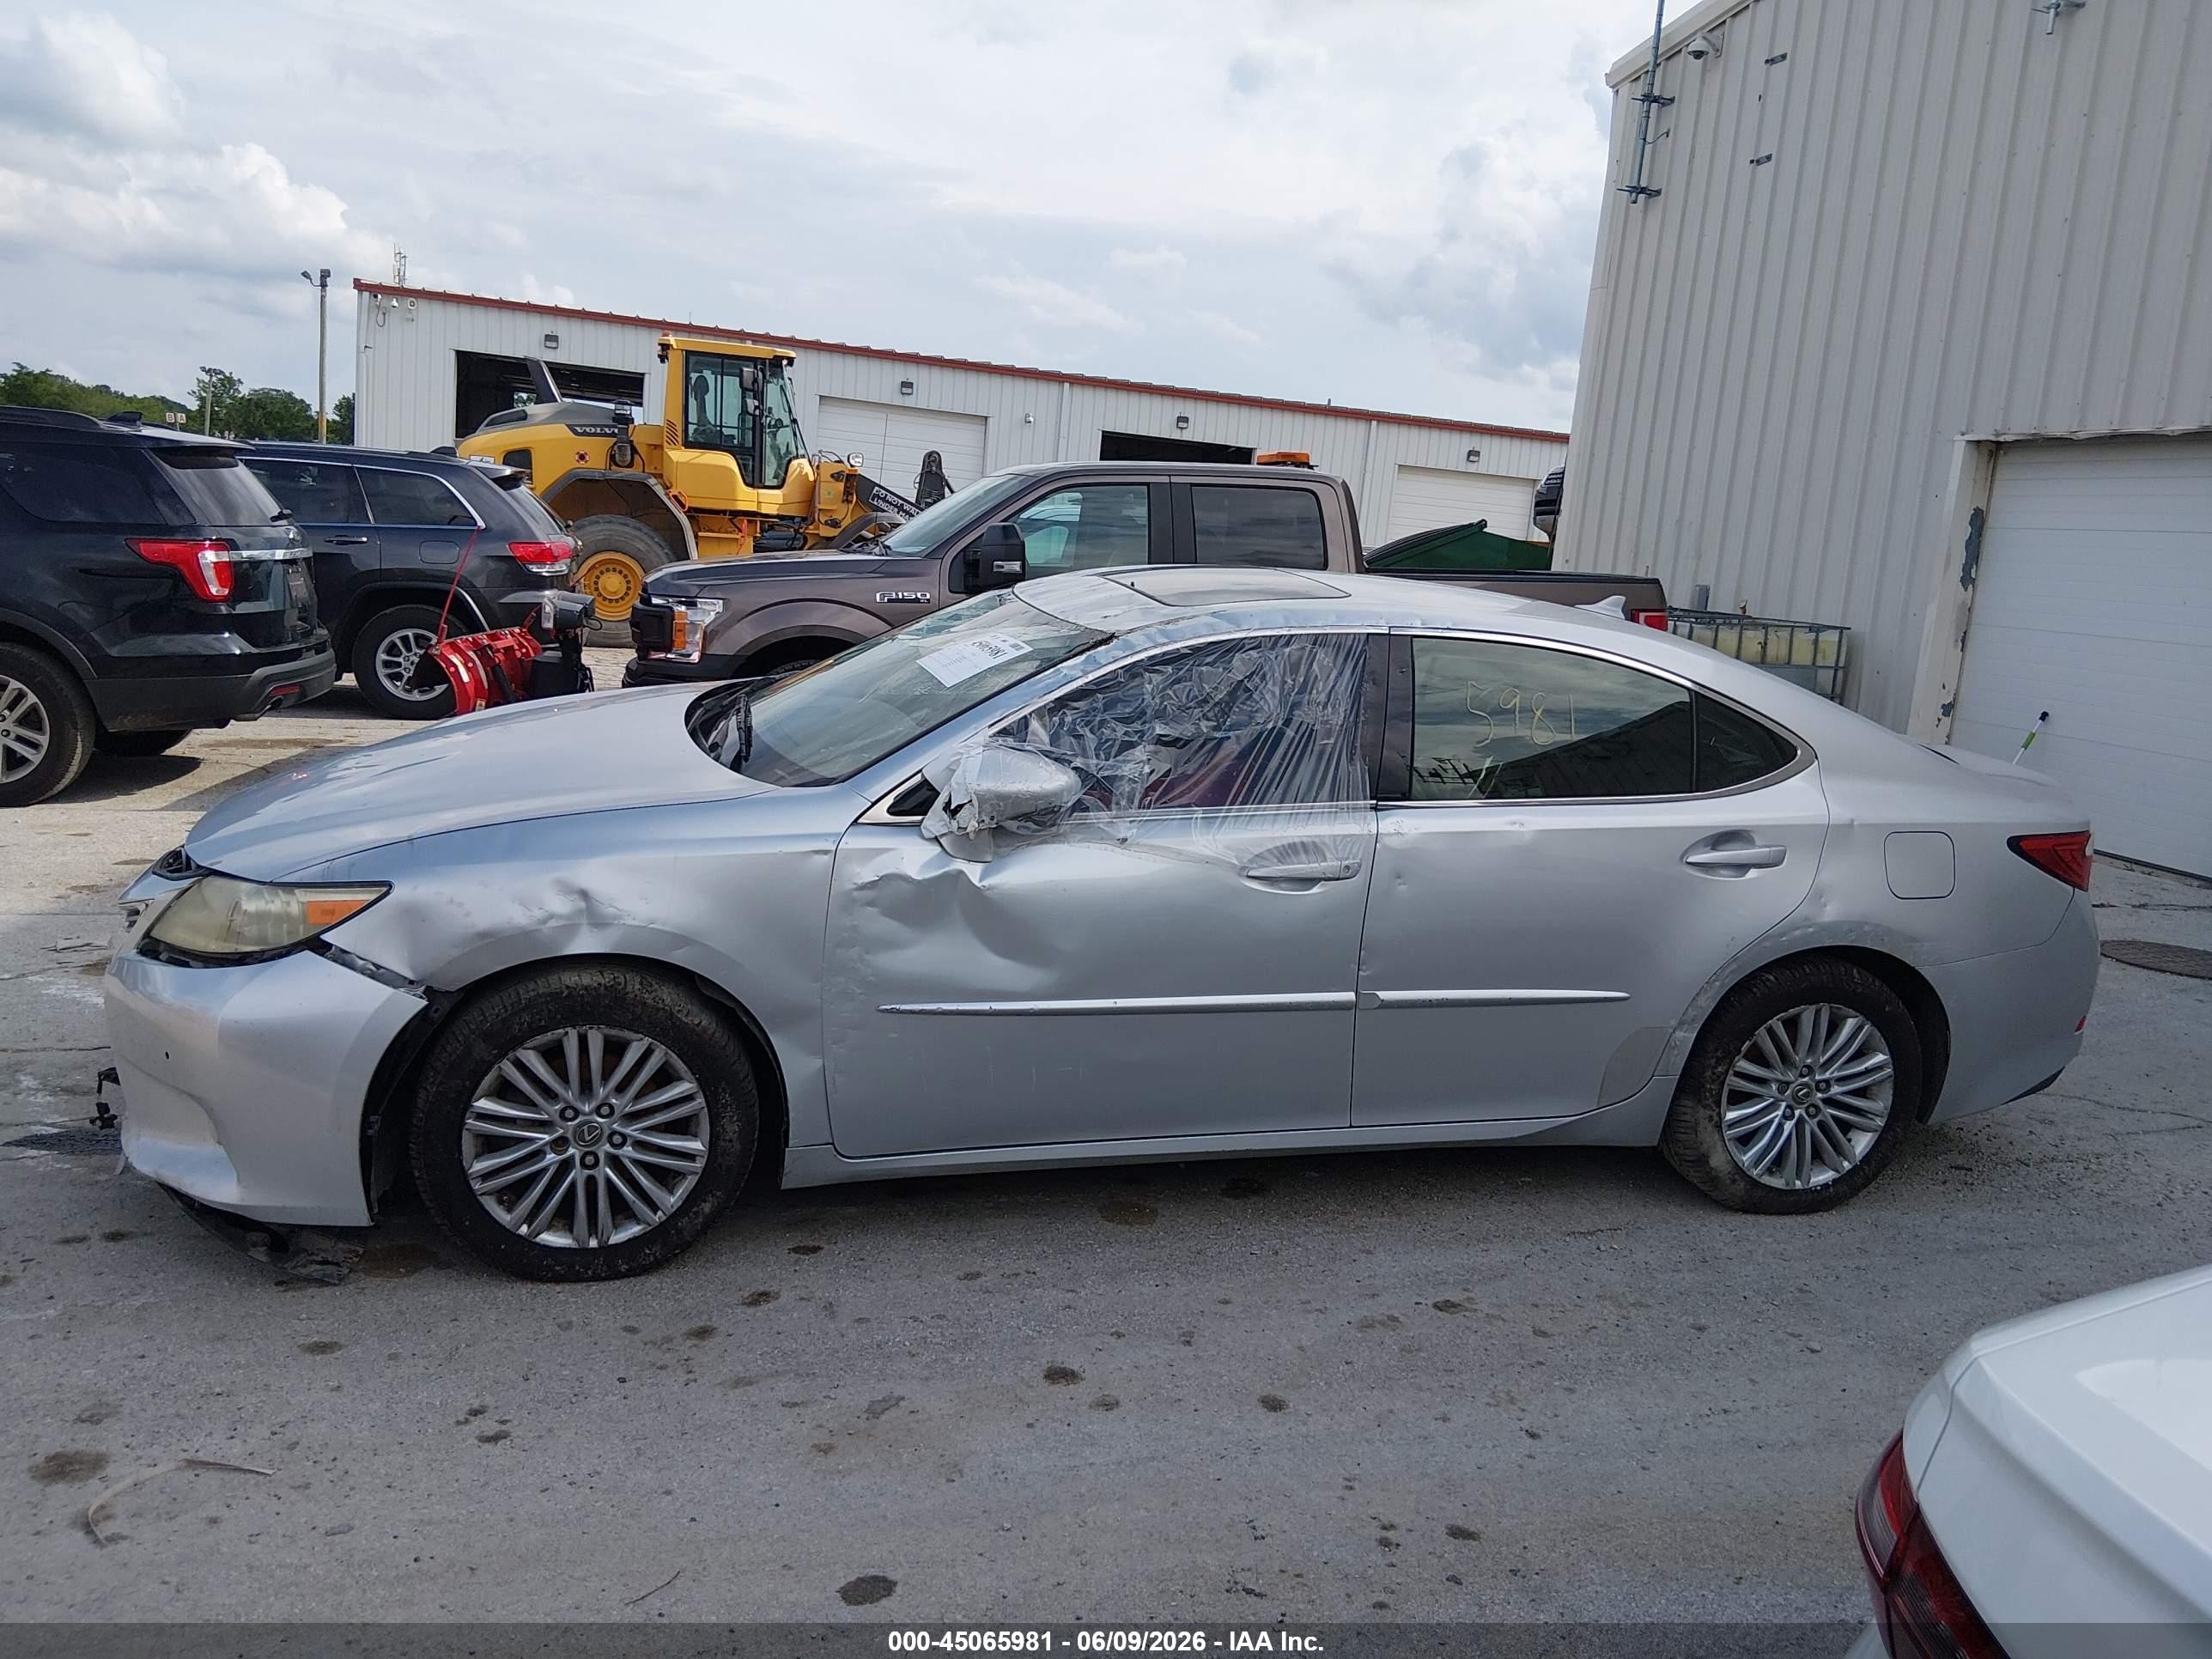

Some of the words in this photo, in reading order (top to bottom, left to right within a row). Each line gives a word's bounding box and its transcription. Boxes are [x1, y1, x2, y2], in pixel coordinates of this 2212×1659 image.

[874, 488, 886, 498] DO
[886, 495, 902, 507] NOT
[874, 498, 899, 515] UNDER
[1465, 680, 1575, 749] 5981
